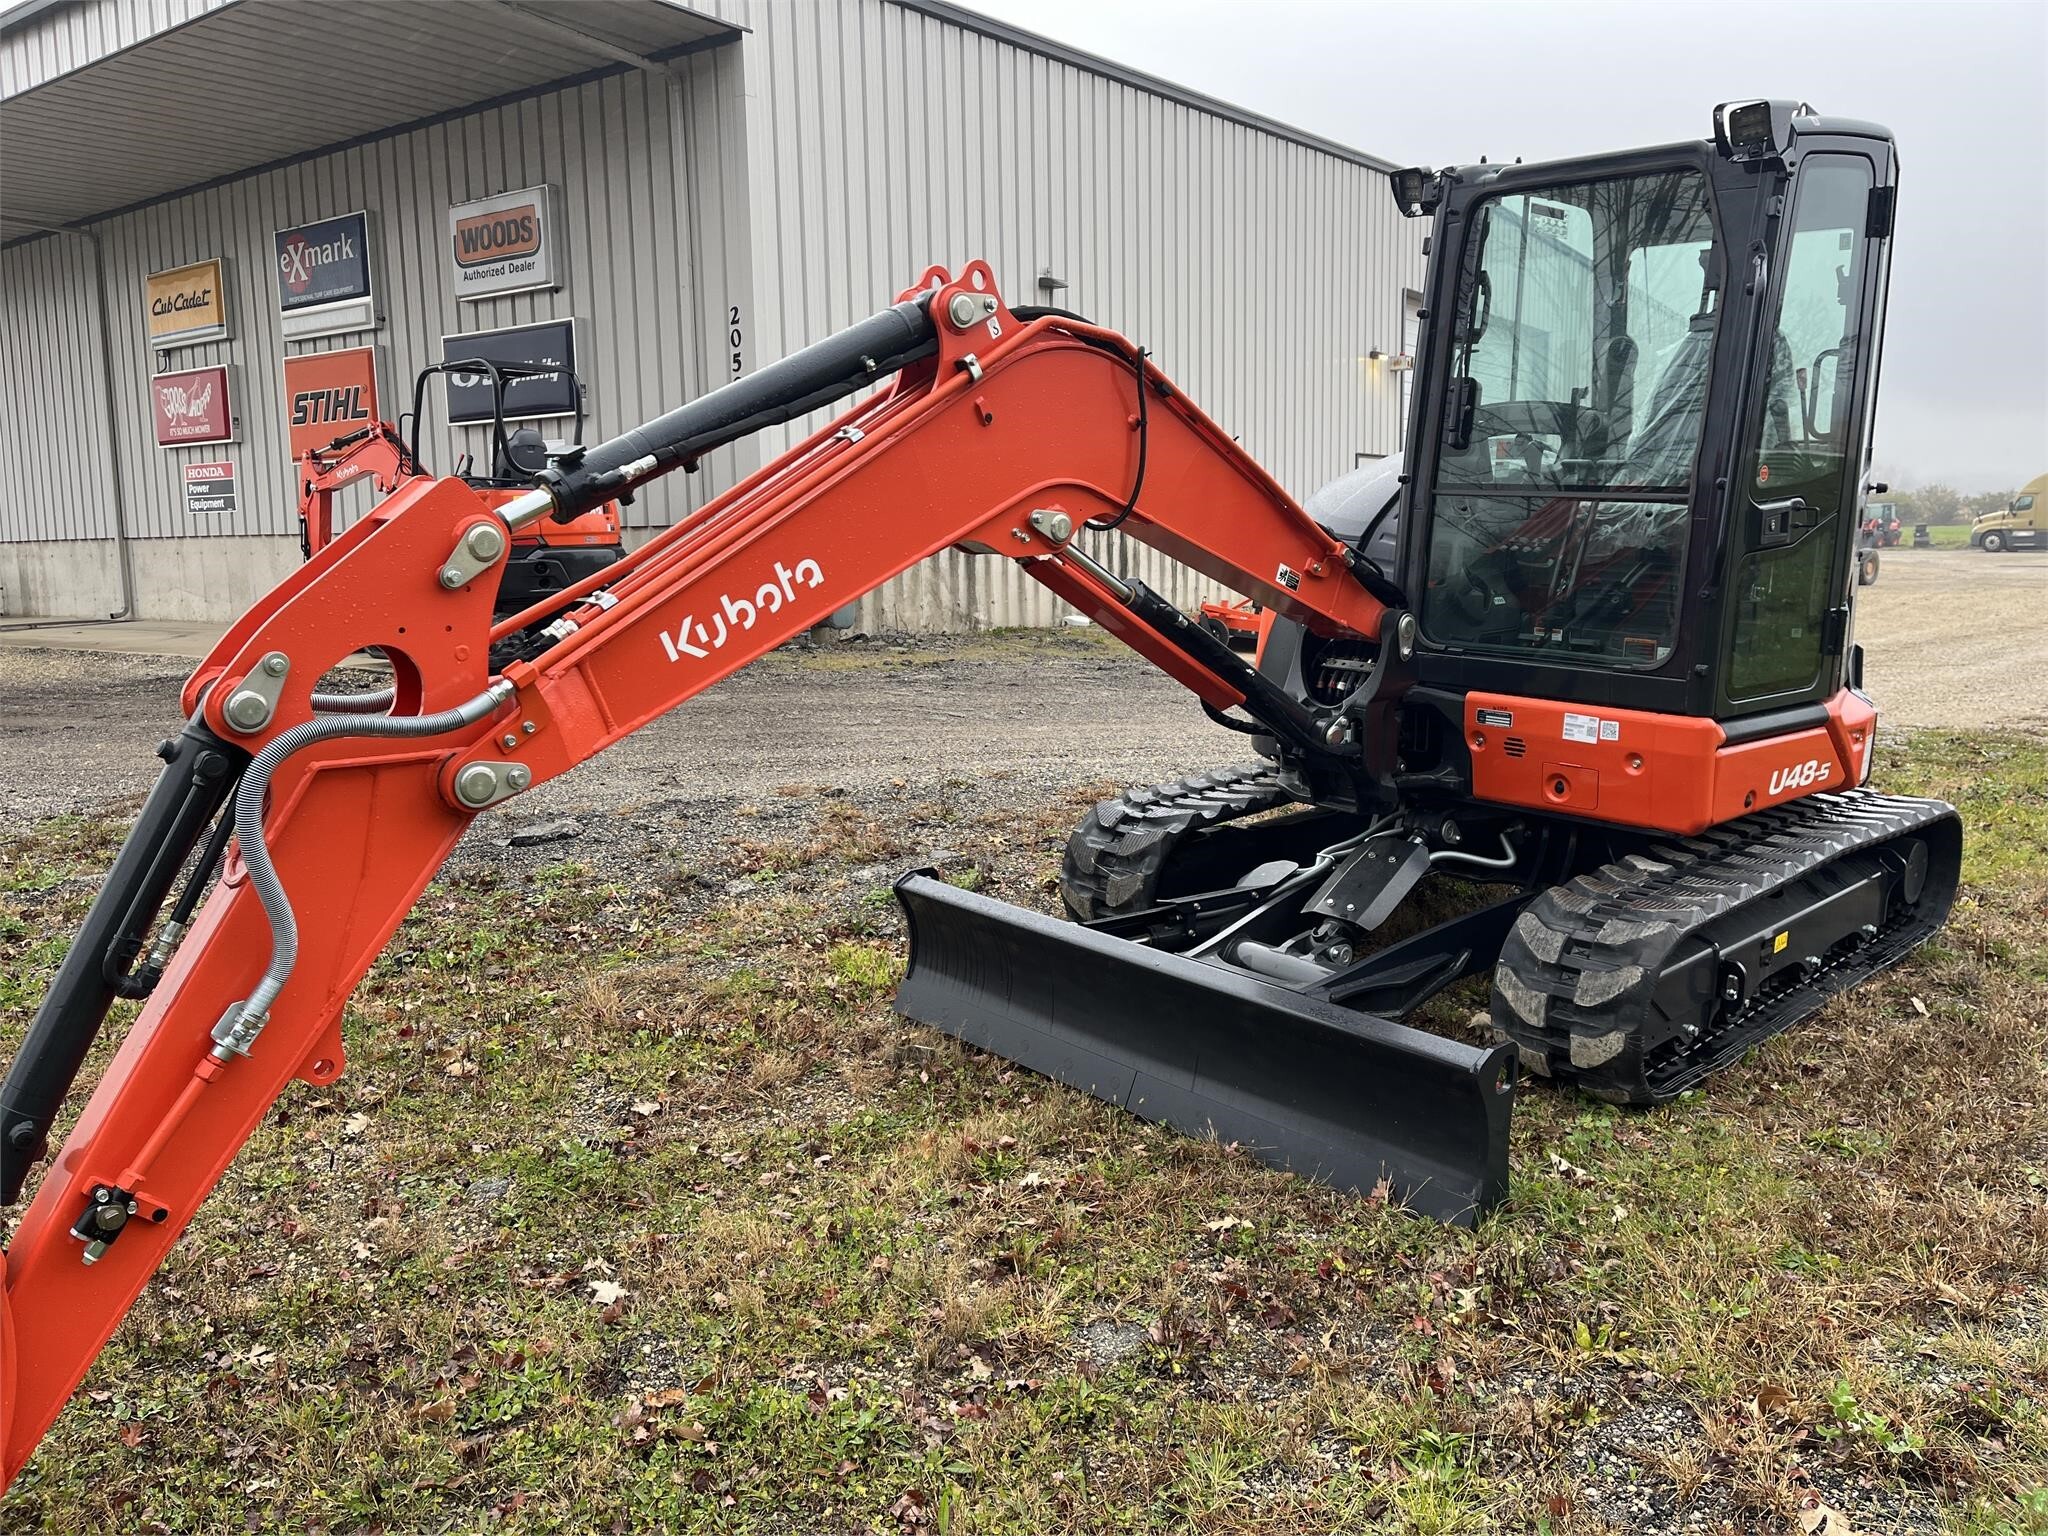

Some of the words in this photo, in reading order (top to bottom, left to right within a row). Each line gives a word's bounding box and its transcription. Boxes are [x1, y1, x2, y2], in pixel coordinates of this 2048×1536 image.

[460, 216, 533, 254] WOODS
[463, 265, 505, 281] Authorized
[508, 261, 535, 274] Dealer
[152, 296, 173, 316] Cub
[174, 289, 211, 311] Cadet
[730, 306, 742, 382] 205
[291, 385, 369, 426] STIHL
[187, 467, 224, 478] HONDA
[189, 484, 209, 494] Power
[190, 498, 224, 510] Equipment
[659, 558, 825, 663] Kubota
[1768, 760, 1832, 795] U48-5
